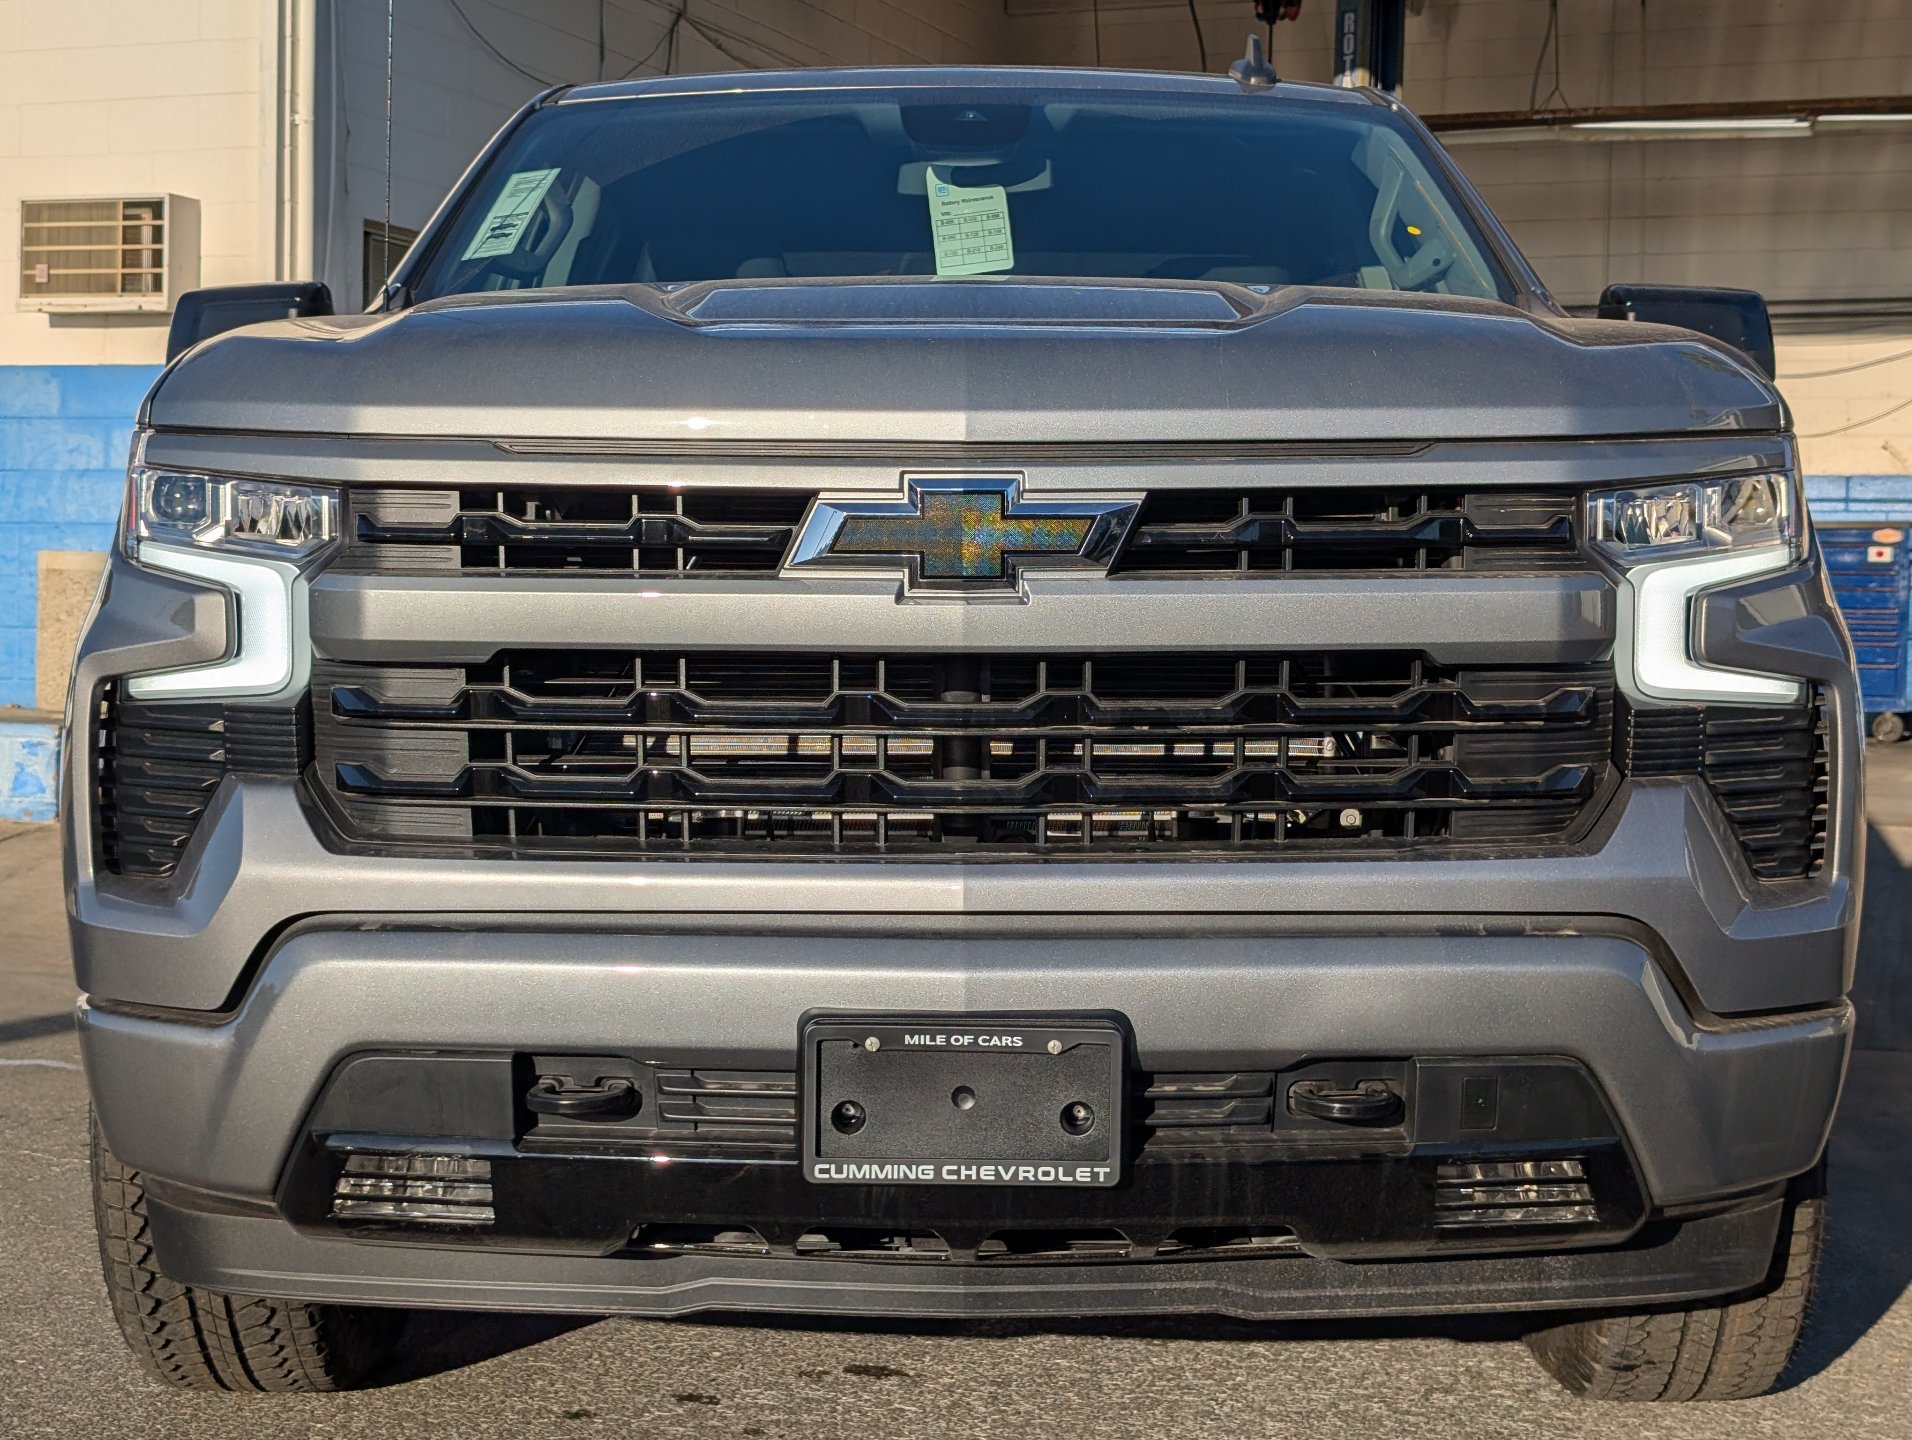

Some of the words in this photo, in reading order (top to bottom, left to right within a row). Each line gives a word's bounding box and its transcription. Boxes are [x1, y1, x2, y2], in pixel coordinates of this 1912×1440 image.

[961, 195, 994, 203] Maintenance
[904, 1034, 946, 1046] MILE
[950, 1034, 974, 1046] OF
[978, 1035, 1023, 1047] CARS
[813, 1163, 935, 1180] CUMMING
[941, 1165, 1110, 1182] CHEVROLET
